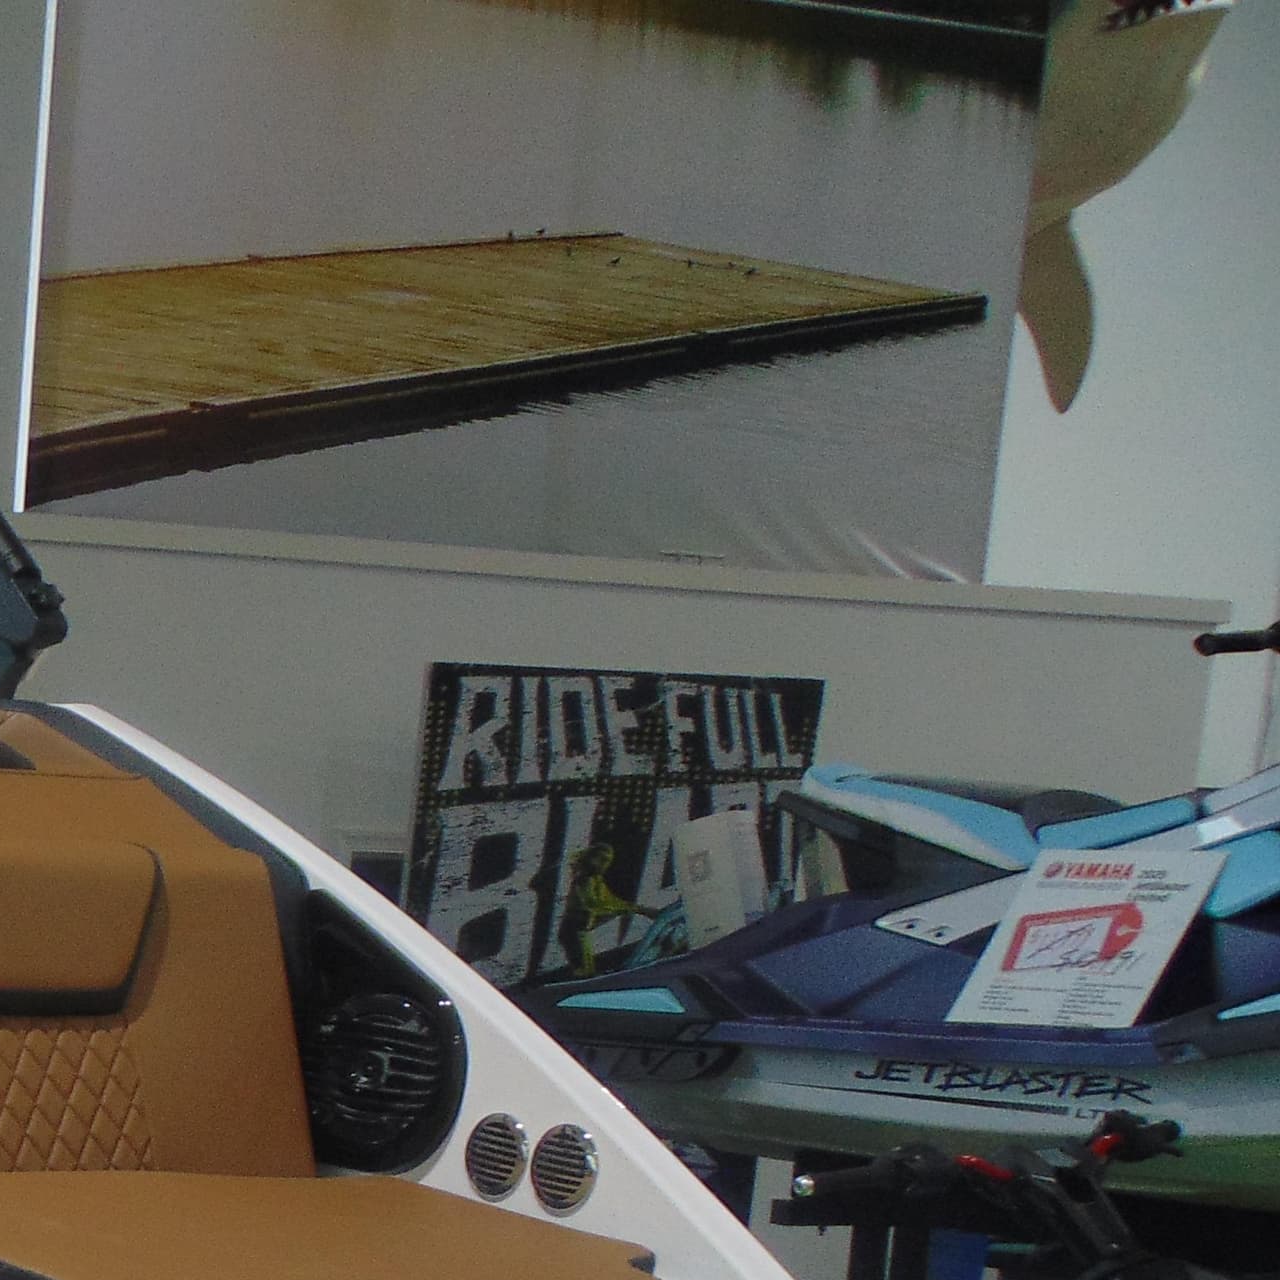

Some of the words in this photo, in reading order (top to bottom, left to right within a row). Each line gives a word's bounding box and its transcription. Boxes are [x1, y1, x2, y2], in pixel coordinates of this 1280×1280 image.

[438, 675, 658, 791] RIDE
[659, 681, 803, 773] FULL
[853, 1058, 1152, 1105] JETBLASTER
